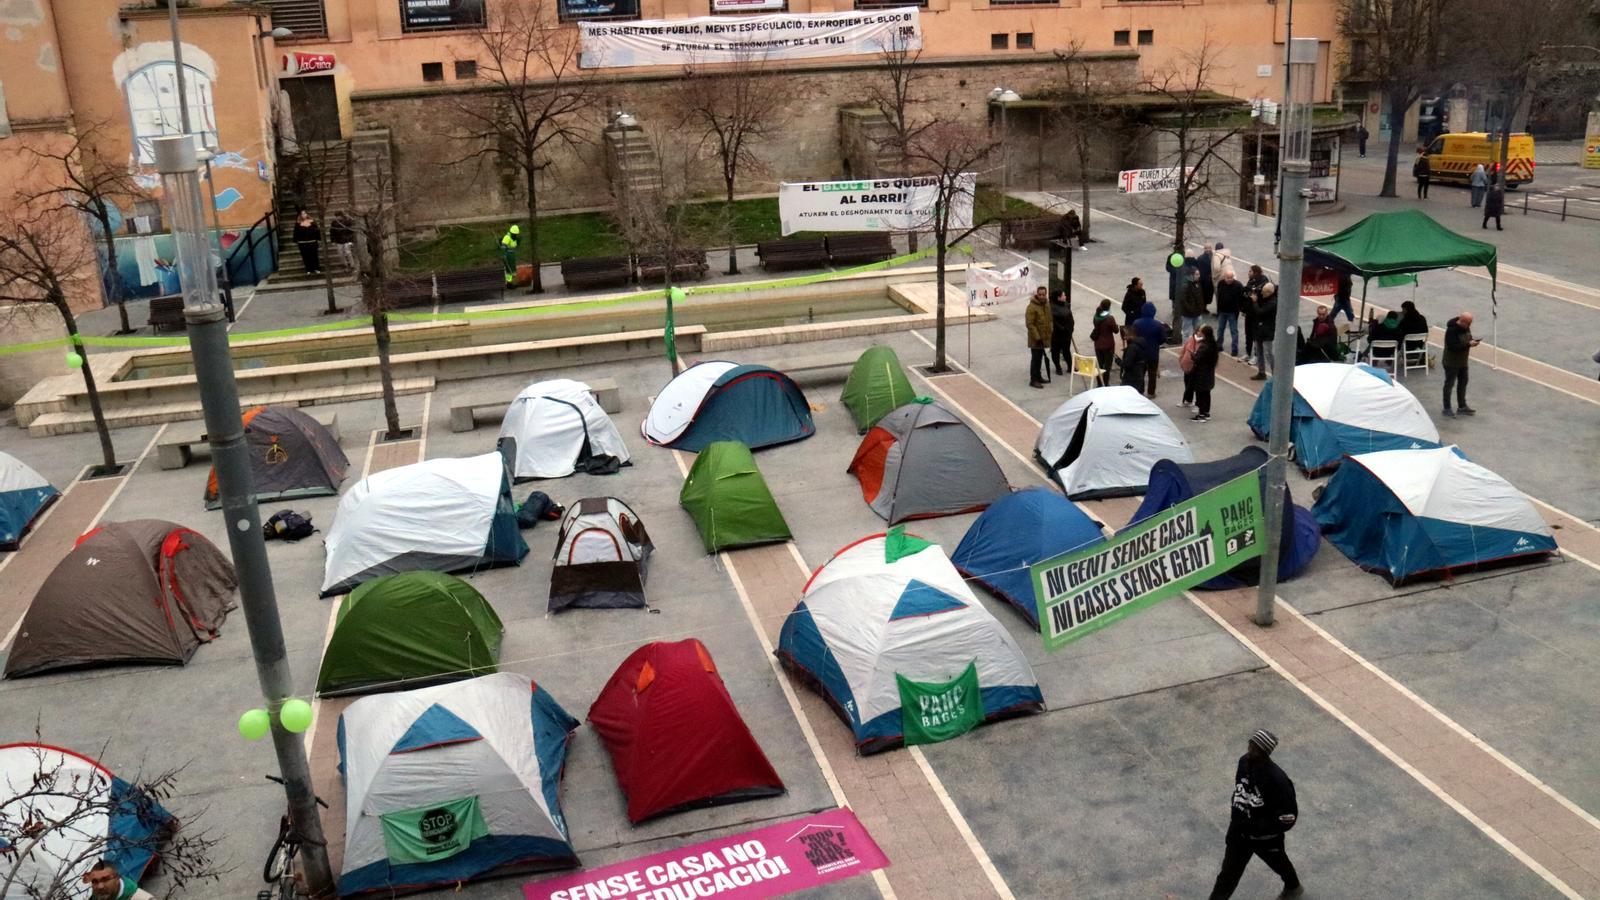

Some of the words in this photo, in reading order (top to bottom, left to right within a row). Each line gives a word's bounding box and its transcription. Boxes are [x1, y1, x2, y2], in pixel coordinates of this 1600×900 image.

[610, 26, 663, 36] HABITATGE
[705, 24, 736, 33] MENYS
[807, 18, 861, 28] EXPROPIEM
[863, 17, 875, 25] EL
[877, 15, 901, 23] BLOC
[793, 38, 804, 46] DE
[803, 184, 819, 192] EL
[874, 180, 890, 189] ES
[893, 177, 938, 189] QUEDA
[1122, 171, 1138, 192] 9F
[840, 195, 857, 204] AL
[861, 193, 908, 203] BARRI!
[1220, 496, 1254, 527] PAHC
[1046, 565, 1068, 599] NI
[1067, 550, 1111, 588] GENT
[1111, 528, 1157, 569] SENSE
[1159, 509, 1195, 549] CASA
[1052, 600, 1074, 634] NI
[1073, 577, 1121, 624] CASES
[1120, 556, 1171, 601] SENSE
[1169, 537, 1210, 579] GENT
[921, 704, 966, 727] BAGES
[422, 813, 453, 831] STOP
[645, 850, 725, 886] CASA
[720, 839, 767, 866] NO
